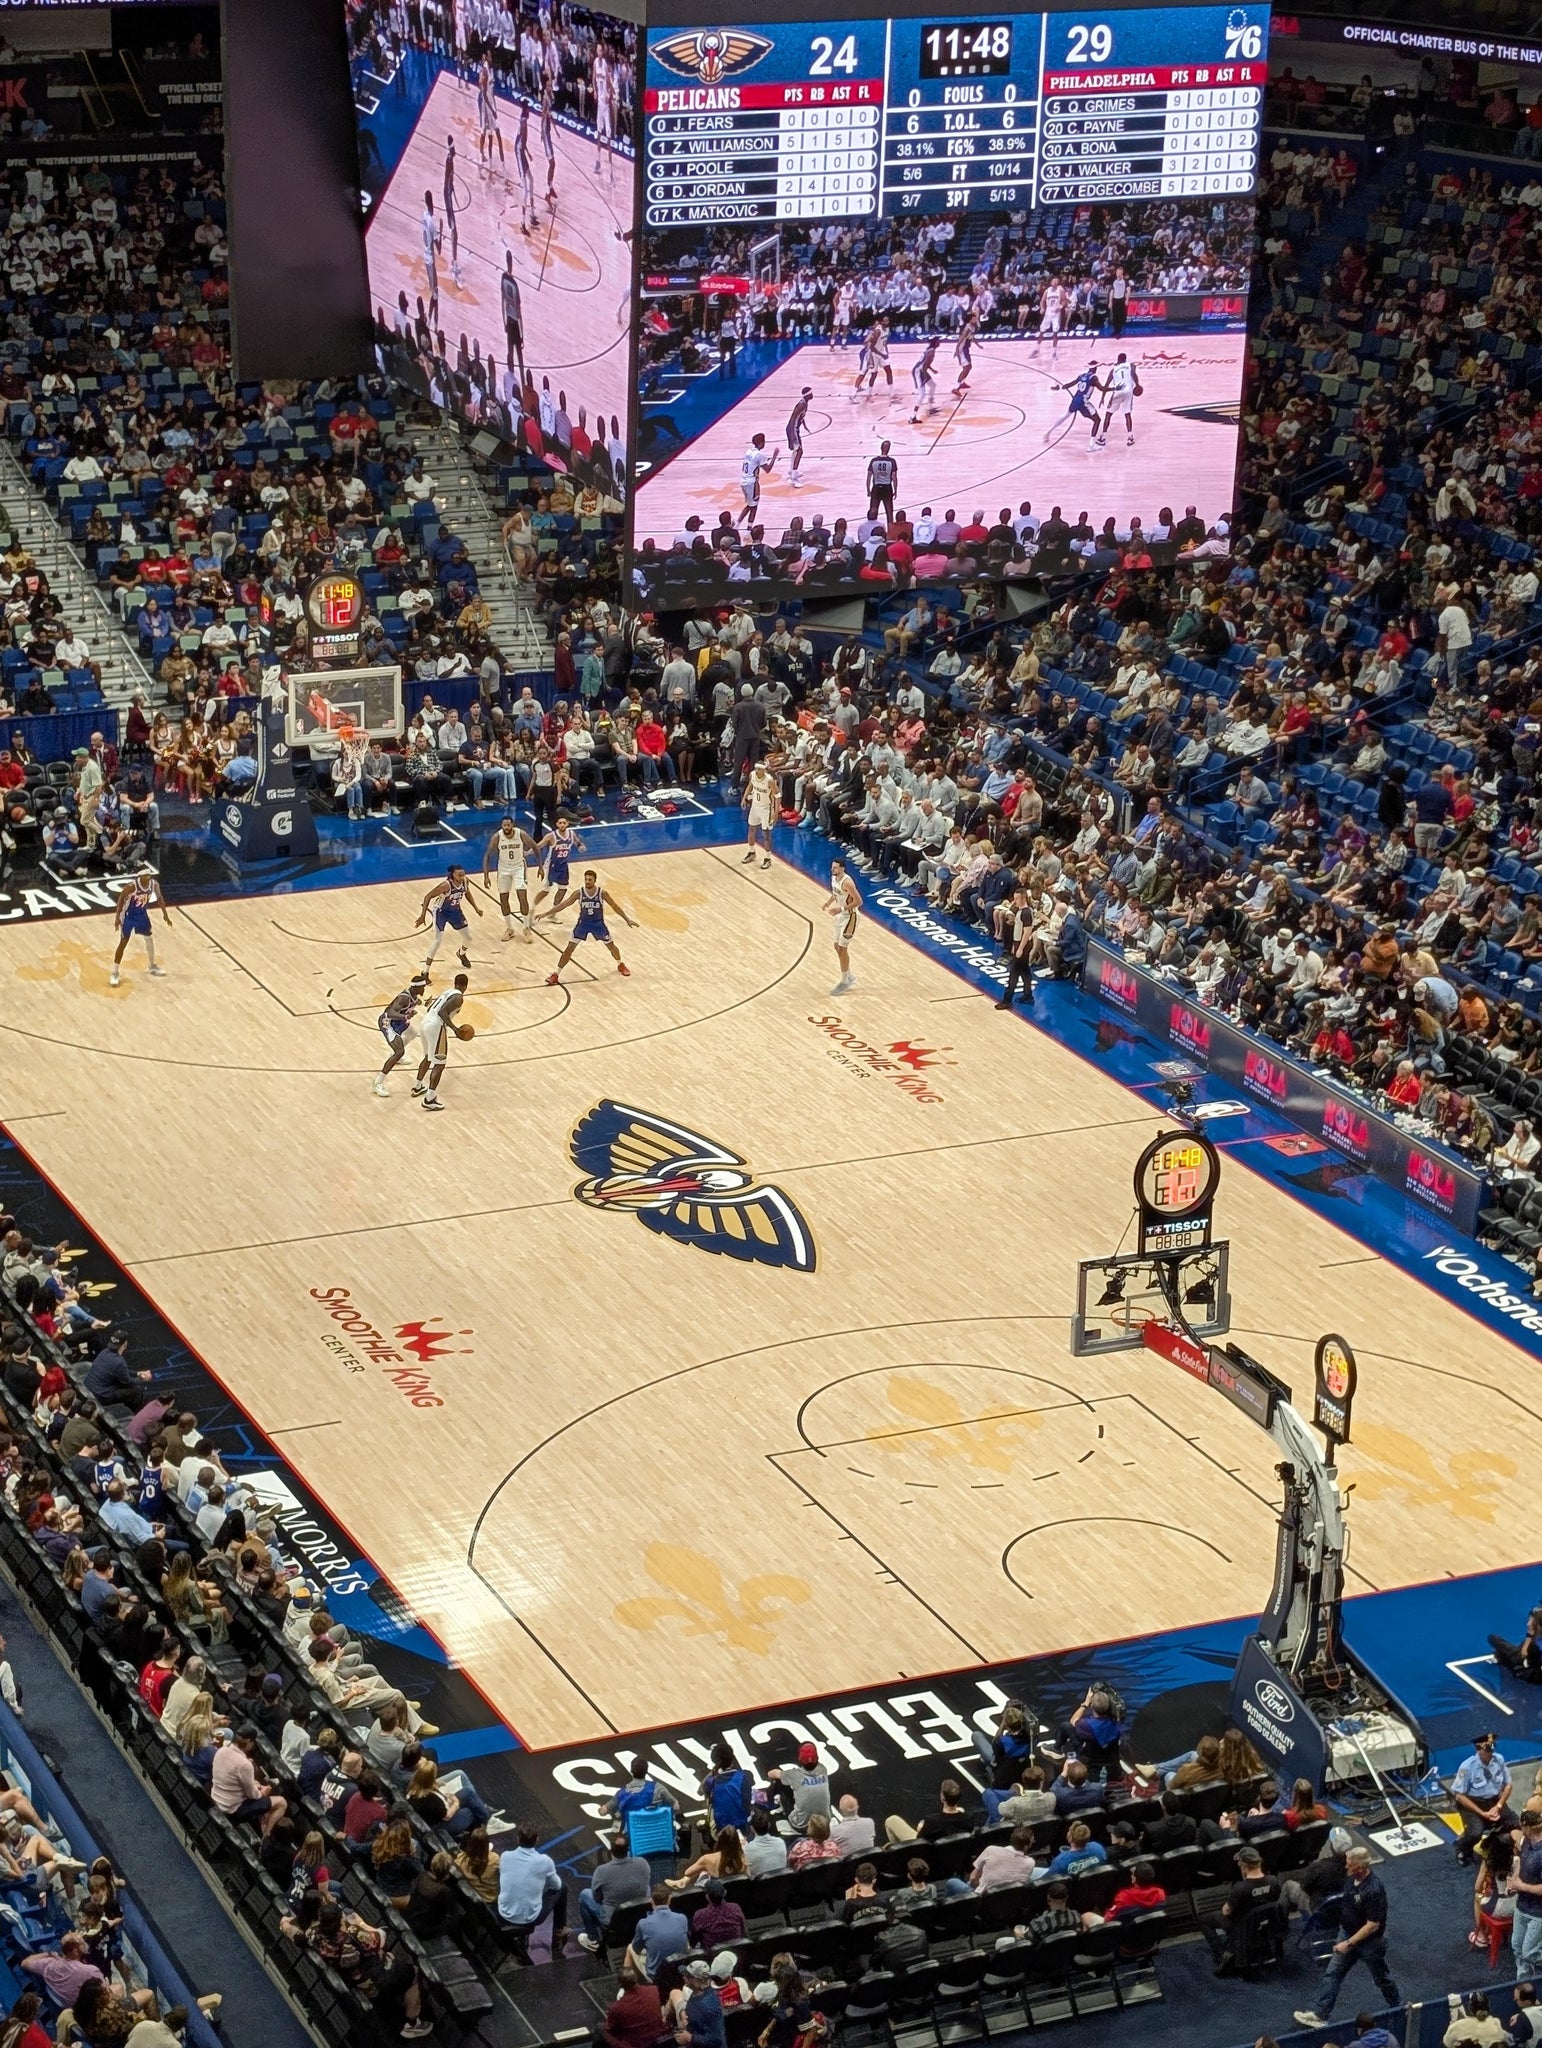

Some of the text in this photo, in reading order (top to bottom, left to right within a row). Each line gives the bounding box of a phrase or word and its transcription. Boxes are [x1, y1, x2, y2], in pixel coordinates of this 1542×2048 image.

[926, 26, 1010, 61] 11:48
[1065, 24, 1112, 64] 29
[1224, 25, 1262, 60] 76
[1343, 25, 1399, 44] OFFICIAL
[1400, 31, 1453, 51] CHARTER
[1454, 39, 1477, 55] BUS
[1478, 43, 1495, 57] OF
[1497, 45, 1519, 60] THE
[809, 35, 857, 76] 24
[159, 84, 194, 94] OFFICIAL
[1050, 67, 1251, 90] PHILADELPHIA PTS RB AST FL
[167, 94, 202, 105] THE NEW
[657, 85, 870, 112] PELICANS PTS RB AST FL
[908, 83, 1016, 108] 0 FOULS 0
[1052, 91, 1249, 114] 5 Q. GRIMES 9 0 0 0
[657, 111, 867, 132] 0 J. FEARS 0 0 0 0
[907, 110, 1015, 134] 6 T.O.L. 6
[1048, 113, 1248, 135] 20 C. PAYNE 0 0 0 0
[659, 133, 842, 154] 1 Z. WILLIAMSON 5 5
[896, 137, 1026, 156] 38.1% FG% 38.9%
[1046, 134, 1247, 156] 30 A. BONA 0 4 0 2
[109, 155, 121, 163] THE
[122, 154, 137, 163] NEW
[656, 155, 865, 177] 3 J. POOLE 0 0 0
[1046, 162, 1131, 178] 33 J. WALKER
[903, 163, 1020, 181] 5/6 FT 10/14
[655, 177, 864, 199] 6 D. JORDAN 2 4 0 0
[901, 188, 1016, 207] 3/7 3PT 5/13
[1045, 181, 1160, 199] 77 V. EDGECOMBE
[653, 204, 759, 222] 17 K. MATKOVIC
[876, 462, 888, 473] 48
[318, 583, 354, 600] 11:48
[329, 598, 351, 624] 12
[325, 632, 360, 643] TISSOT
[508, 850, 514, 860] 6
[876, 890, 970, 955] Ochsner
[1100, 960, 1138, 1005] NOLA
[1170, 1003, 1210, 1049] NOLA
[807, 1016, 902, 1072] SMOOTHIE
[826, 1049, 871, 1079] CENTER
[1245, 1050, 1287, 1097] NOLA
[1323, 1098, 1369, 1149] NOLA
[1407, 1150, 1456, 1203] NOLA
[1163, 1218, 1209, 1234] TISSOT
[309, 1287, 405, 1364] SMOOTHIE
[320, 1334, 366, 1374] CENTER
[145, 1484, 156, 1499] 0
[275, 1508, 371, 1596] MORRIS
[1260, 1684, 1289, 1718] Ford
[1242, 1699, 1295, 1751] SOUTHERN QUALITY
[1247, 1714, 1287, 1756] FORD DEALERS
